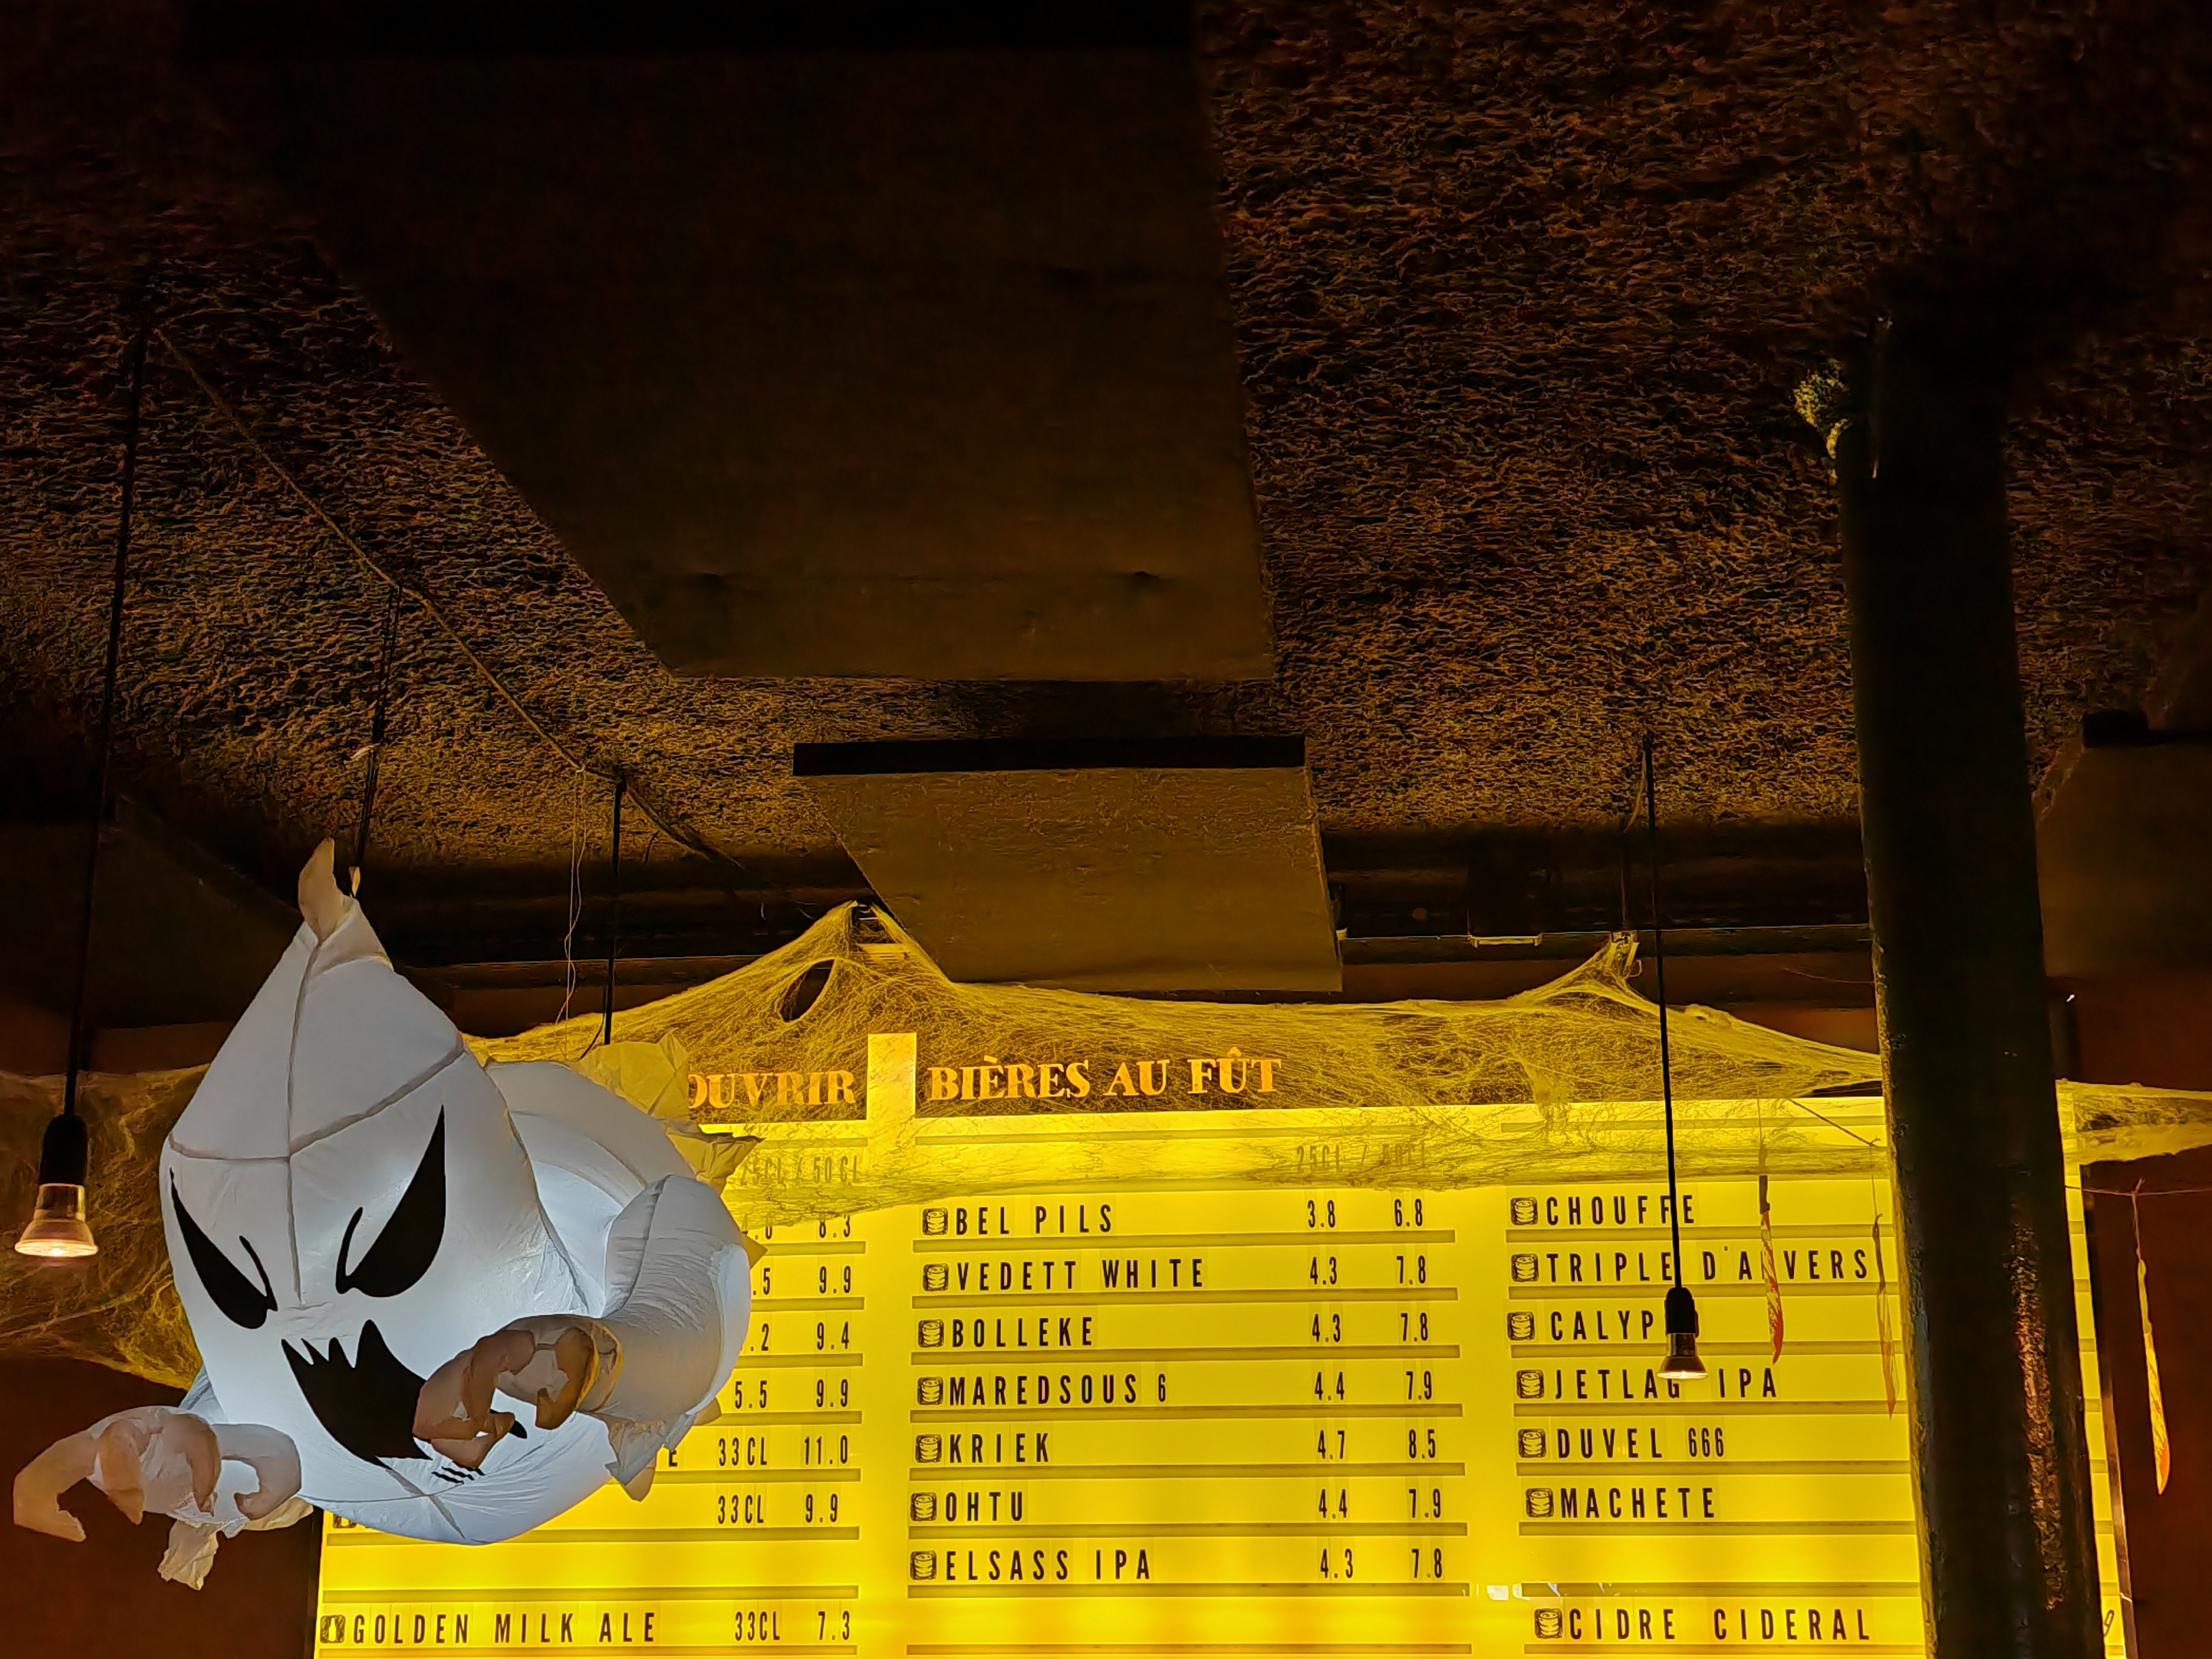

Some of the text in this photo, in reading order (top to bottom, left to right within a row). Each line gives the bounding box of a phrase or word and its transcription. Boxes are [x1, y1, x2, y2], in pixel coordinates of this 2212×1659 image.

[928, 1046, 1282, 1100] BIÈRES AU FÛT
[956, 1198, 1423, 1235] BEL PILS 3.8 6.8
[1545, 1194, 1695, 1226] CHOUFFE
[819, 1266, 851, 1294] 9.9
[957, 1255, 1426, 1291] VEDETT WHITE 4.3 7.8
[1546, 1252, 1673, 1282] TRIPLE
[817, 1322, 849, 1350] 9.4
[952, 1312, 1428, 1347] BOLLEKE 4.3 7.8
[1550, 1311, 1654, 1340] CALYP
[735, 1379, 848, 1409] 5.5 9.9
[950, 1370, 1432, 1406] MAREDSOUS 6 4.4 7.9
[1555, 1368, 1776, 1399] JETLAG IPA
[719, 1437, 768, 1466] 33CL
[804, 1435, 848, 1465] 11.0
[950, 1429, 1436, 1463] KRIEK 4.7 8.5
[1557, 1427, 1724, 1459] DUVEL 666
[718, 1493, 838, 1524] 33CL 9.9
[945, 1488, 1441, 1522] OHTU 4.4 7.9
[1560, 1487, 1714, 1518] MACHETE
[946, 1548, 1442, 1581] ELSASS IPA 4.3 7.8
[354, 1611, 850, 1644] GOLDEN MILK ALE 33CL 7.3
[1569, 1608, 1869, 1640] CIDRE CIDERAL
